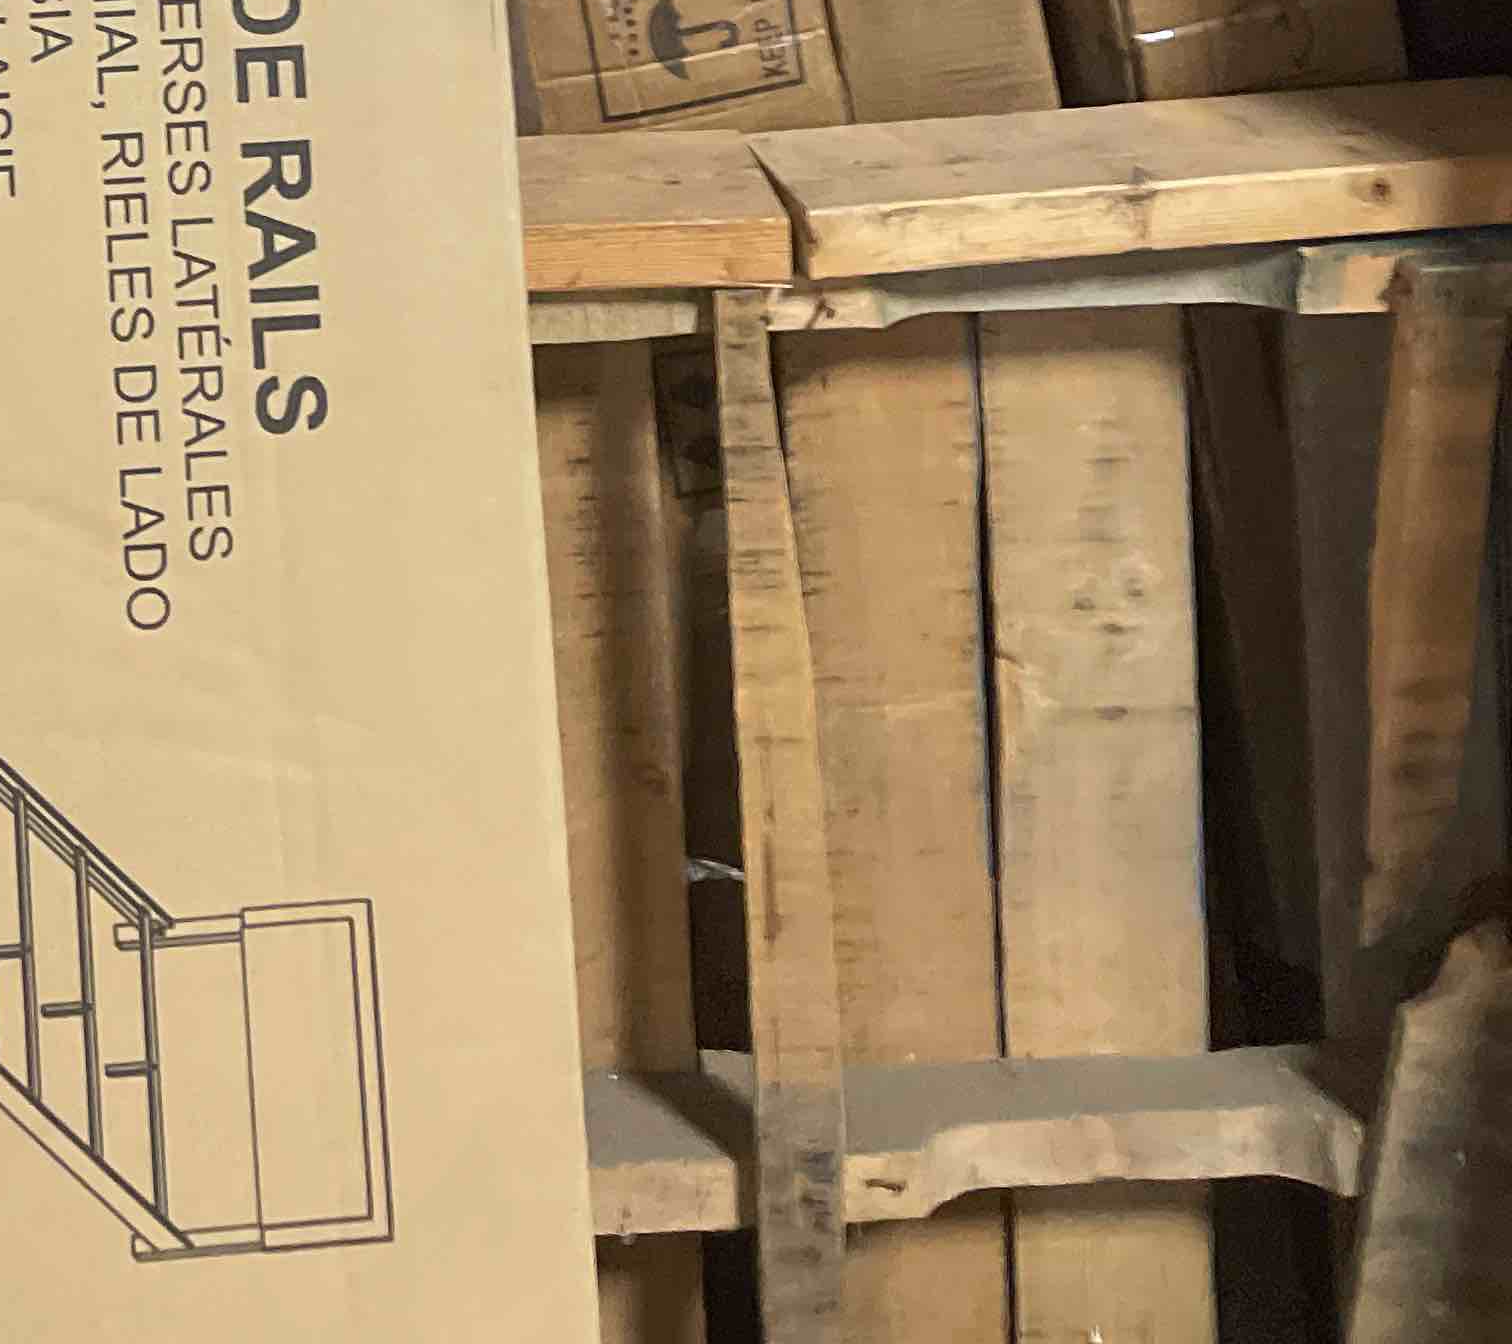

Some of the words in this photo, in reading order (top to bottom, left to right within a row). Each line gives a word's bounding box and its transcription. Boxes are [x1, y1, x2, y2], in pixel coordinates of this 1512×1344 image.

[101, 132, 155, 342] RIELES
[240, 139, 328, 434] RAILS
[113, 365, 160, 445] DE
[171, 217, 233, 561] LATÉRALES
[119, 467, 171, 630] LADO
